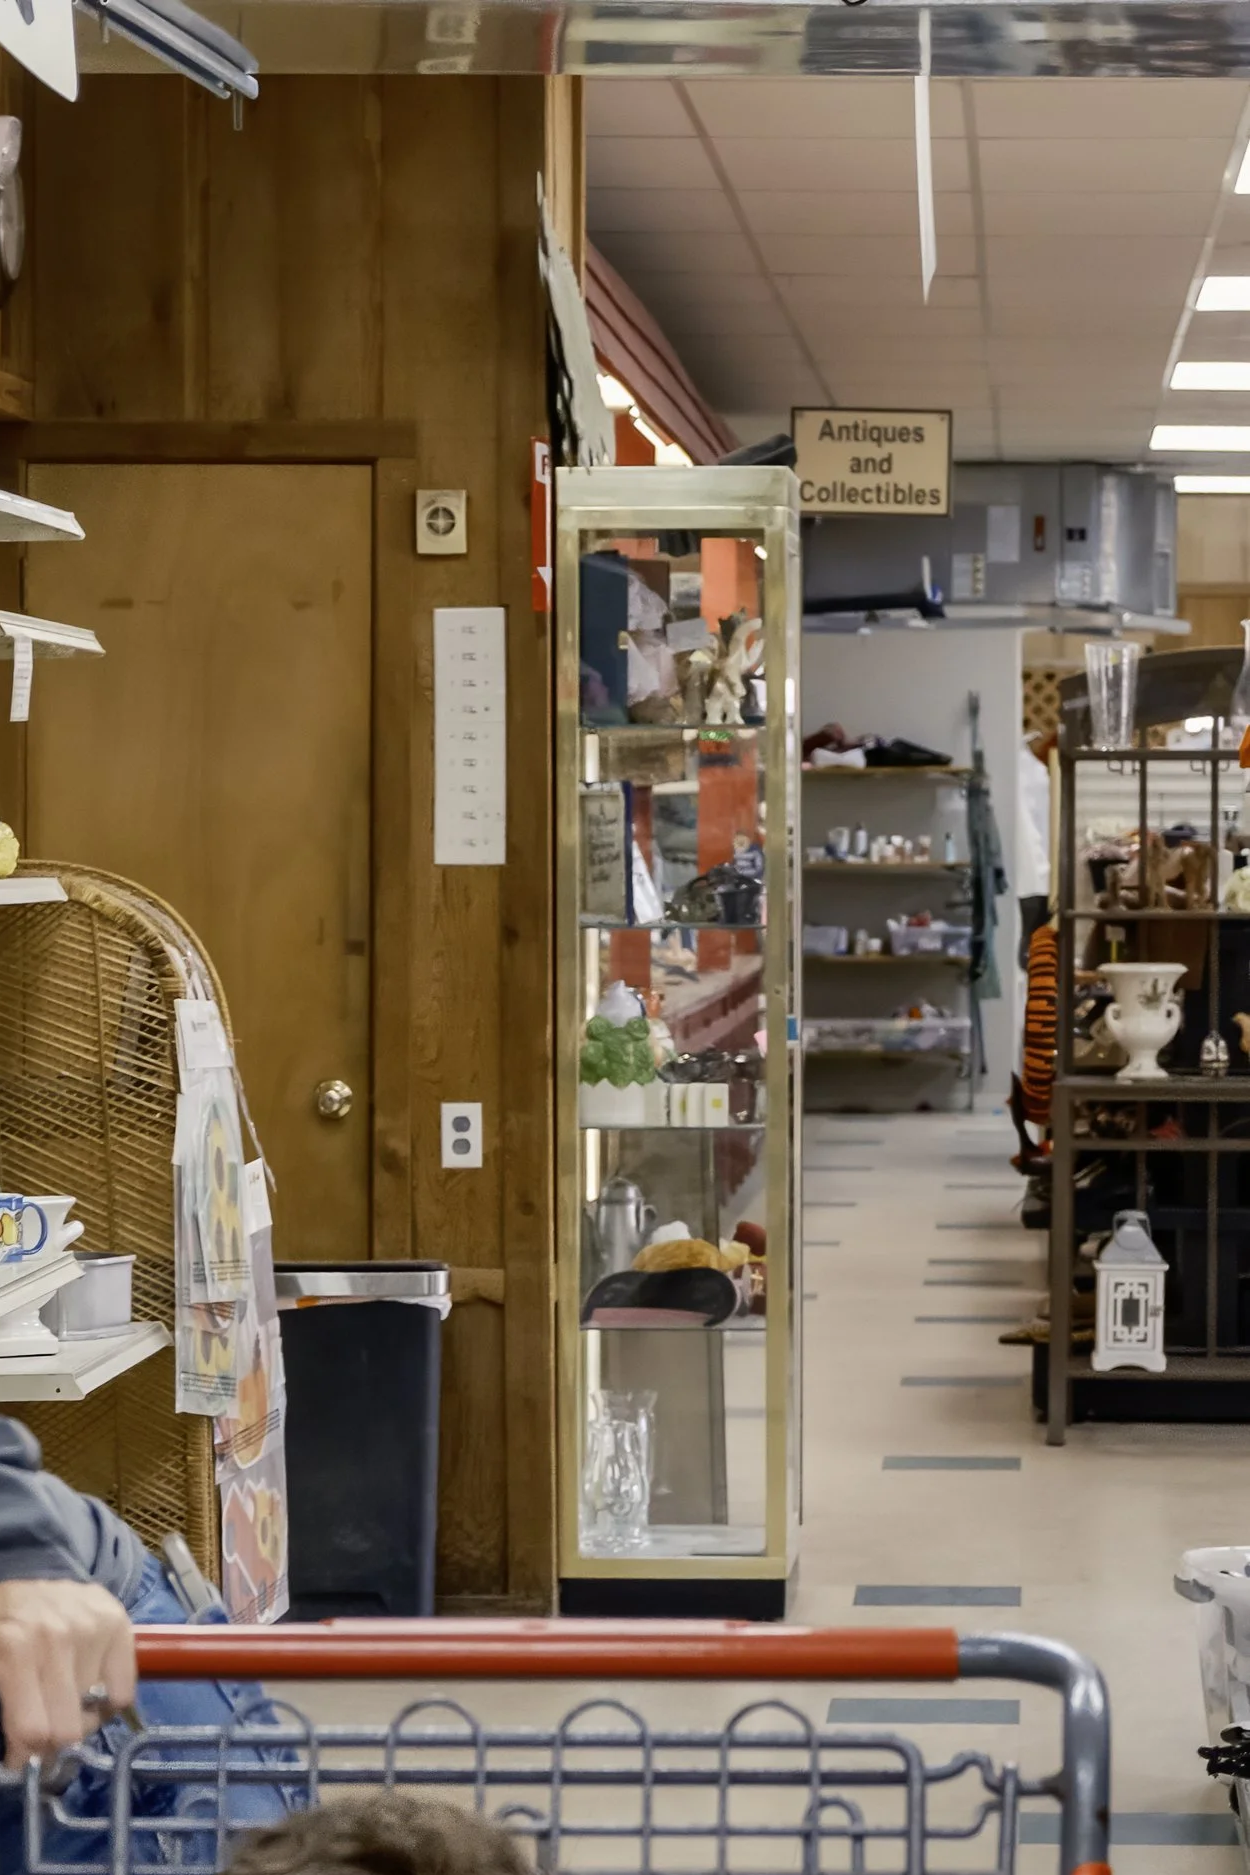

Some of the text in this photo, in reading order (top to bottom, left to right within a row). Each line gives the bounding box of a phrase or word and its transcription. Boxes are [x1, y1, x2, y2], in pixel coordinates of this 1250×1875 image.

[818, 418, 925, 448] Antiques
[849, 452, 893, 475] and
[800, 480, 942, 506] Collectibles
